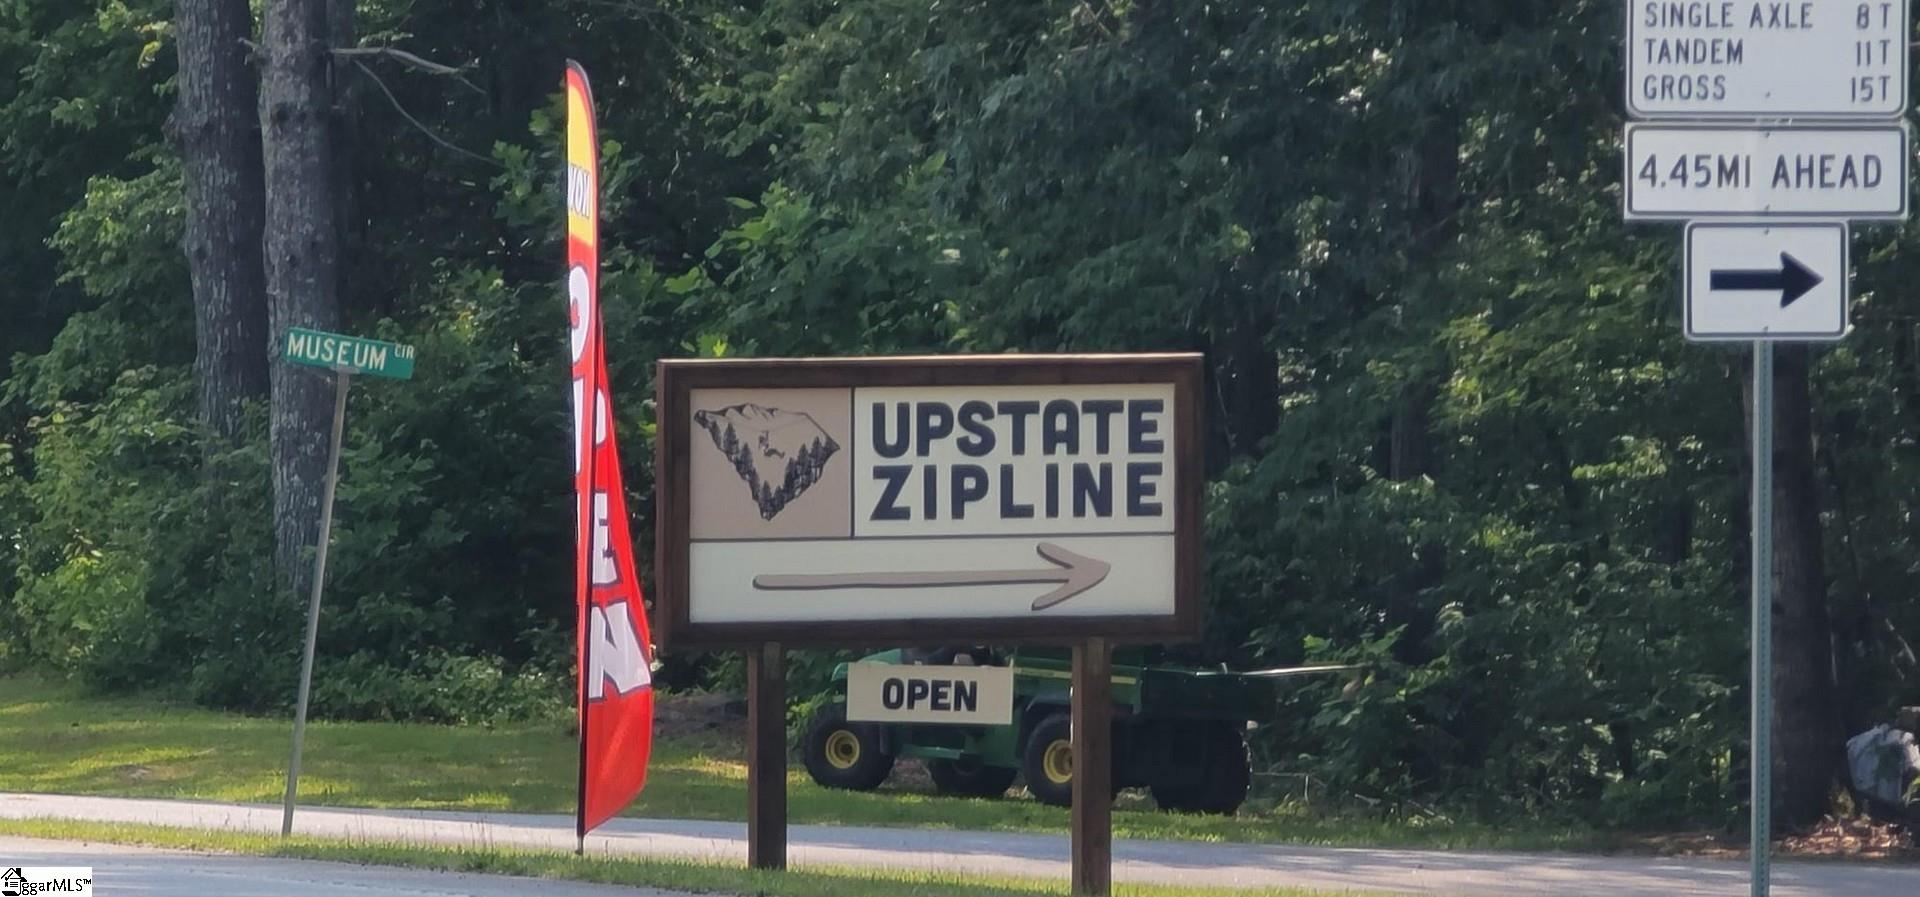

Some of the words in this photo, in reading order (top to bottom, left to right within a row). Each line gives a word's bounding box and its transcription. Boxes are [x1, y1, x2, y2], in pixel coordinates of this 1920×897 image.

[1644, 1, 1734, 28] SINGLE
[1749, 2, 1813, 29] AXLE
[1644, 38, 1744, 64] TANDEM
[1643, 74, 1726, 100] GROSS
[1638, 153, 1750, 188] 4.45MI
[1771, 153, 1882, 189] AHEAD
[287, 332, 387, 371] MUSEUM
[394, 343, 415, 359] CIR
[872, 399, 1164, 458] UPSTATE
[869, 462, 1163, 521] ZIPLINE
[882, 677, 978, 712] OPEN
